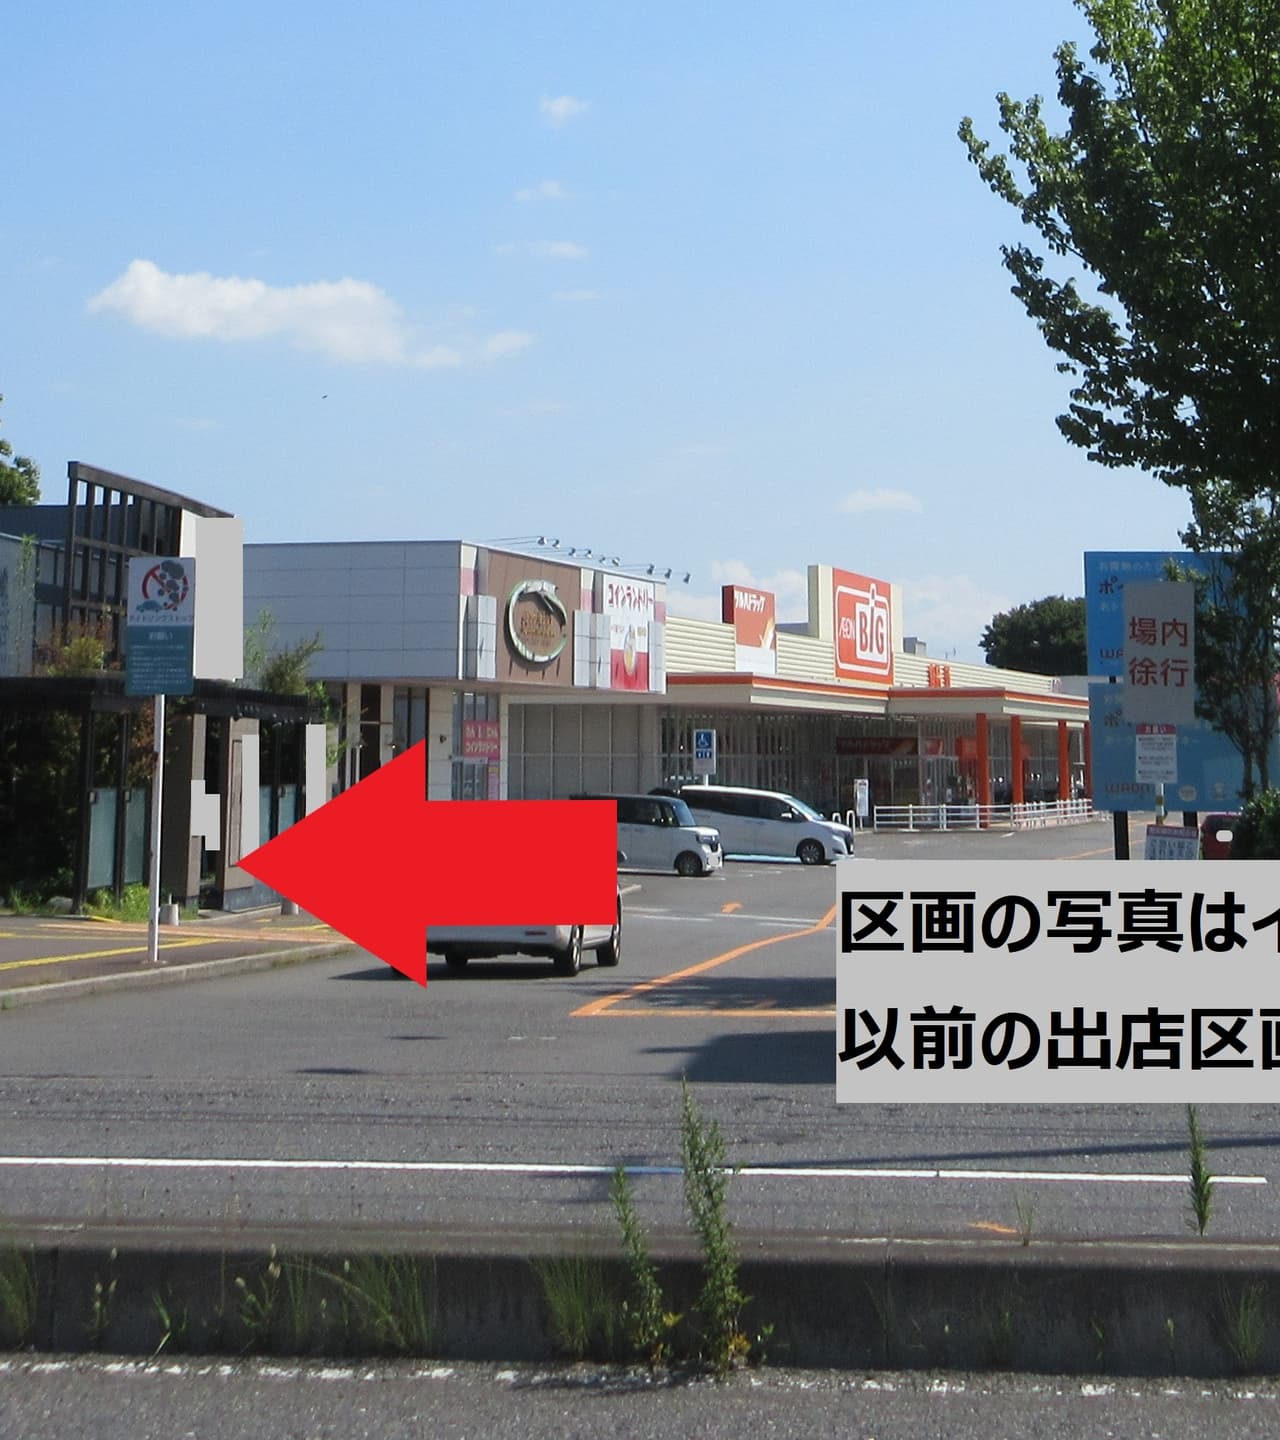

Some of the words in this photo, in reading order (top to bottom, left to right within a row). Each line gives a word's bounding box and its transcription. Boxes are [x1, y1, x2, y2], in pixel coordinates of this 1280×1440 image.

[608, 583, 654, 611] コインランドリー
[1128, 616, 1189, 648] 場内
[1128, 656, 1189, 688] 徐行
